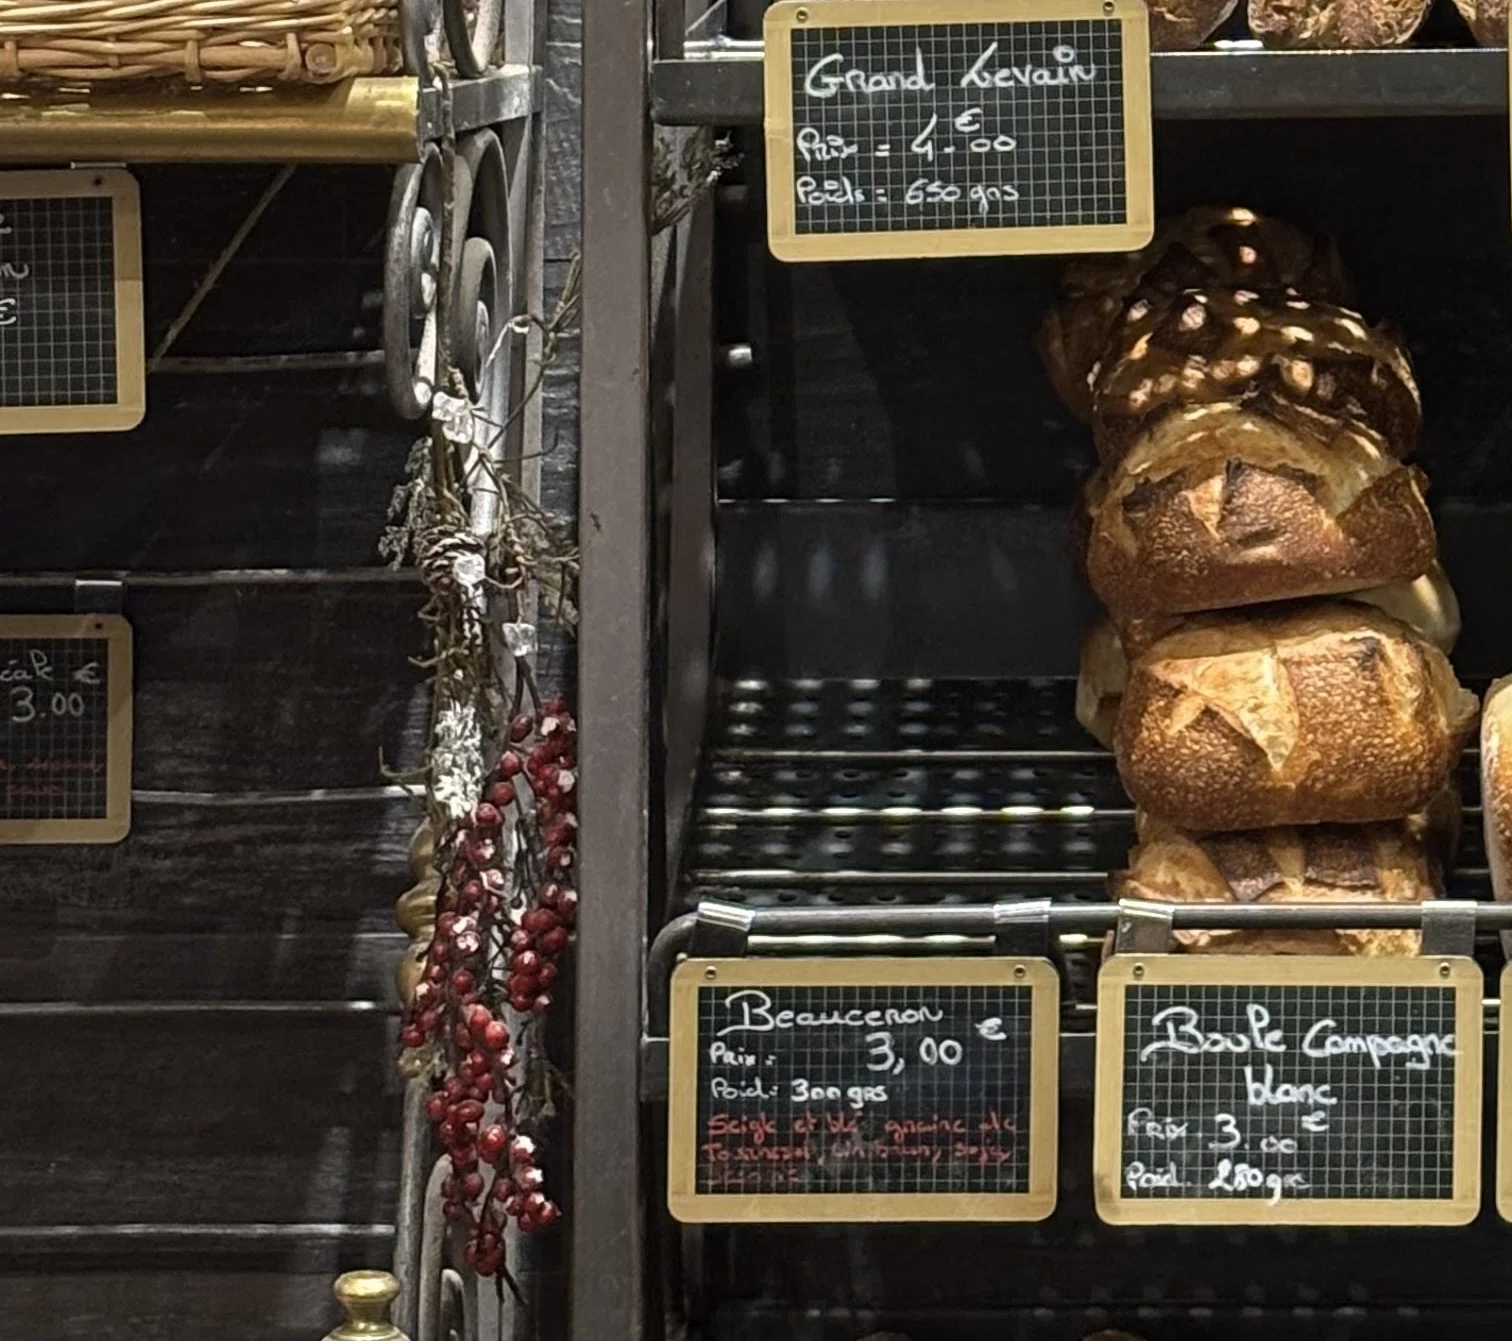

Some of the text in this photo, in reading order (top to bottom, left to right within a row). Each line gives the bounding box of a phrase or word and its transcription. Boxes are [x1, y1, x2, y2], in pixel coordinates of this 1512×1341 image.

[805, 42, 1097, 98] Grand Levain
[906, 177, 961, 205] 650
[10, 686, 85, 722] 3.00
[716, 989, 944, 1037] Beauceron
[1141, 1003, 1463, 1070] Boule Campagne
[791, 1078, 841, 1102] 300
[1244, 1064, 1338, 1106] blanc
